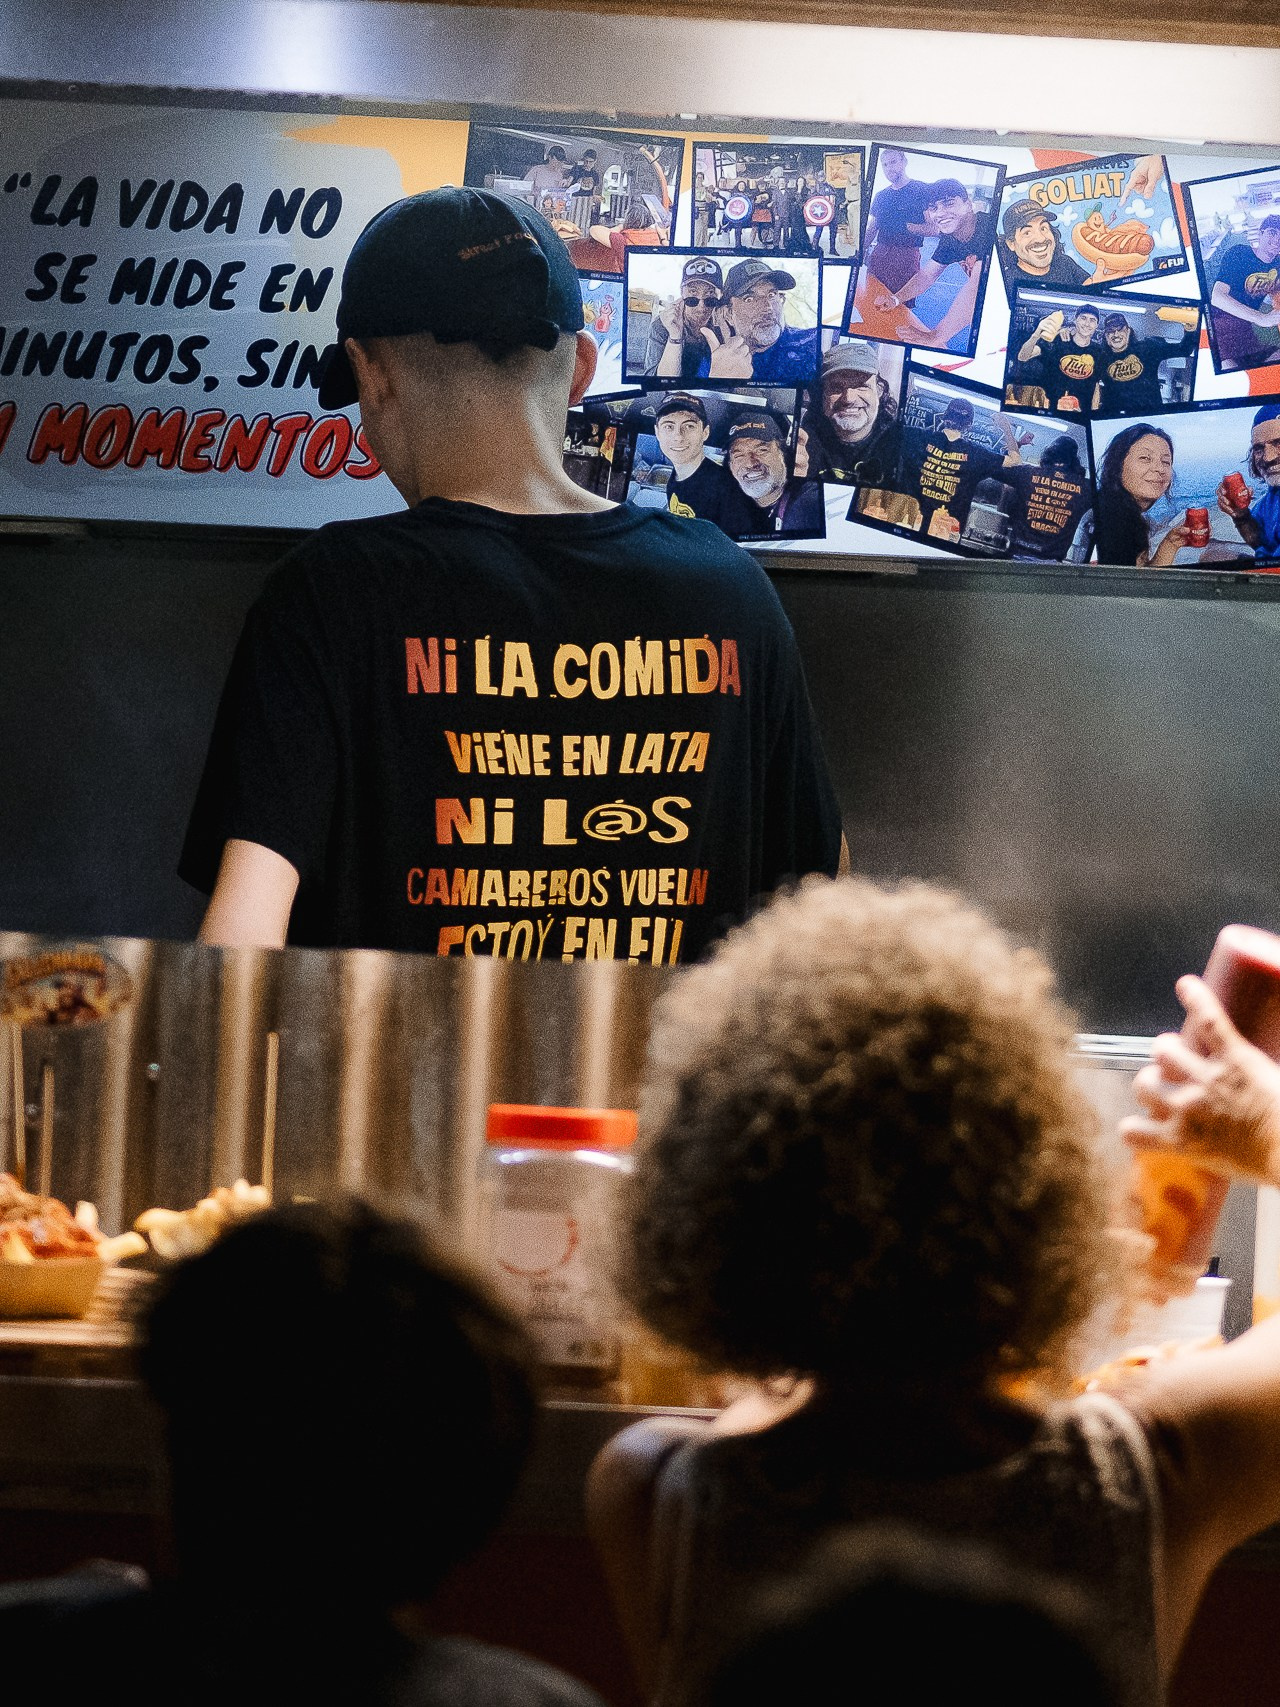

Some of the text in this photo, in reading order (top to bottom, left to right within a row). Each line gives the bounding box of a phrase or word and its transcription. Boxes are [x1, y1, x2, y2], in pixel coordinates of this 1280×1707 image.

[119, 179, 244, 234] VIDA
[259, 186, 343, 239] NO
[1029, 172, 1125, 208] GOLIAT
[25, 253, 334, 313] SE MIDE EN
[0, 327, 219, 392] INUTOS,
[27, 401, 383, 480] MOMENTOS
[475, 637, 538, 698] LA
[563, 735, 610, 776] EN
[619, 732, 710, 774] LATA
[543, 796, 692, 845] L@S
[406, 867, 611, 907] CAMAREROS
[562, 916, 618, 965] EN
